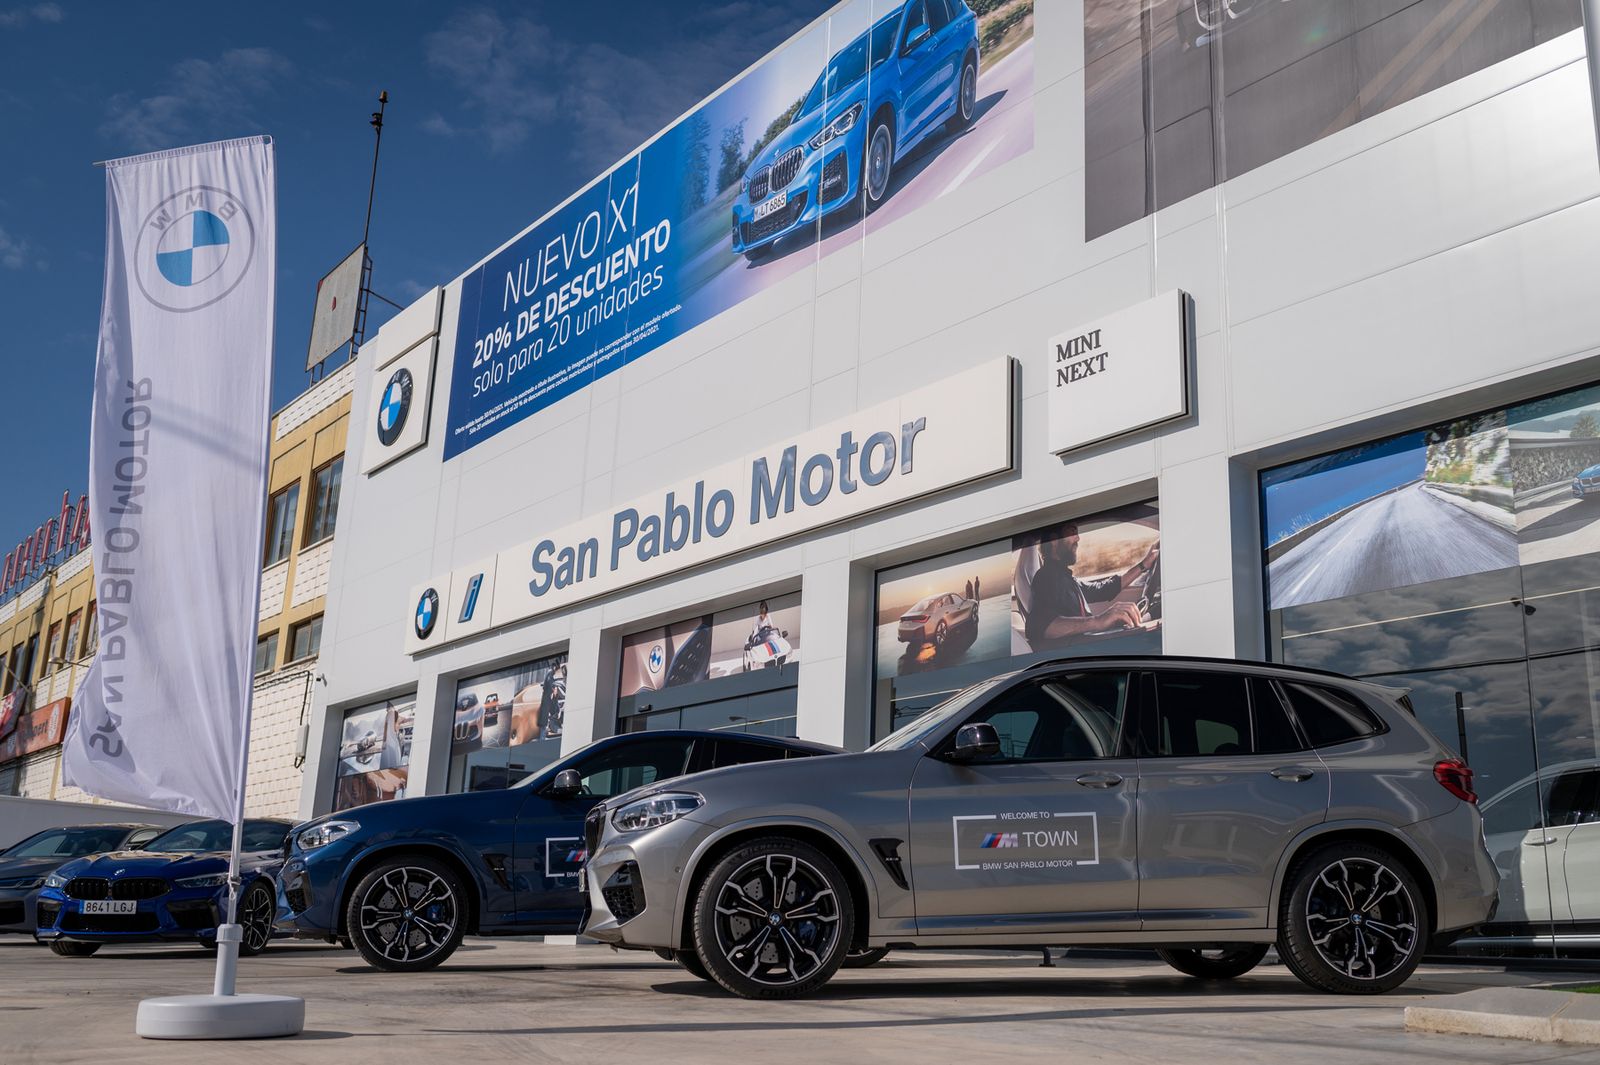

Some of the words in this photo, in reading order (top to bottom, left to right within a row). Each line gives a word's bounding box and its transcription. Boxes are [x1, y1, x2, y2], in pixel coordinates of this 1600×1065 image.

[503, 211, 601, 312] NUEVO
[606, 181, 639, 244] X1
[472, 321, 512, 369] 20%
[515, 301, 541, 342] DE
[544, 218, 671, 323] DESCUENTO
[473, 359, 504, 398] solo
[506, 337, 544, 383] para
[547, 314, 571, 353] 20
[576, 264, 664, 336] unidades
[644, 316, 661, 327] modelo
[1056, 329, 1102, 363] MINI
[1056, 352, 1108, 387] NEXT
[528, 536, 599, 597] San
[609, 480, 735, 571] Pablo
[749, 416, 927, 525] Motor
[1000, 812, 1038, 820] WELCOME
[1039, 811, 1050, 819] TO
[1022, 830, 1078, 848] TOWN
[982, 863, 1002, 871] BMW
[1004, 862, 1019, 870] SAN
[1020, 861, 1045, 869] PABLO
[1046, 860, 1073, 868] MOTOR
[85, 902, 110, 913] 8641
[113, 902, 134, 913] LGJ
